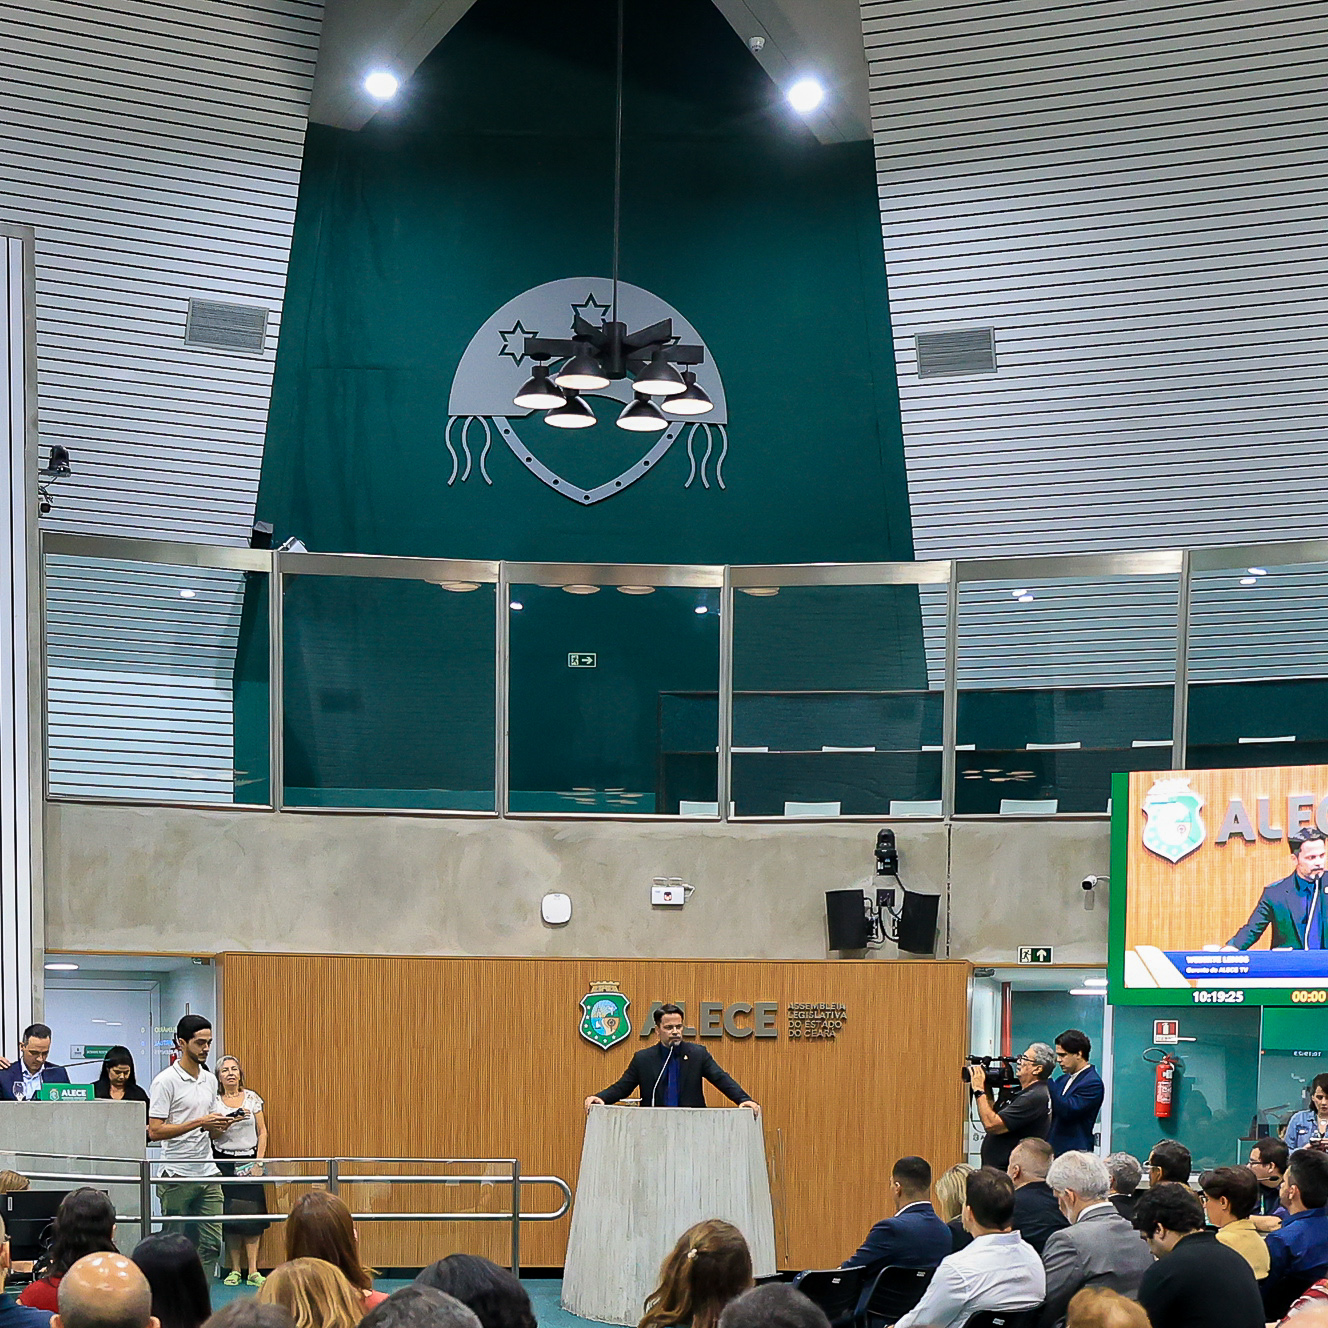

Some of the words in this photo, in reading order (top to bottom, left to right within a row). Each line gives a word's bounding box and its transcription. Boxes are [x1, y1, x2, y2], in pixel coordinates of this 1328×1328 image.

[1192, 990, 1244, 1003] 10:19:25
[1291, 990, 1327, 1003] 00:00
[787, 1002, 846, 1011] ASSEMBLEIA
[788, 1011, 847, 1020] LEGISLATIVA
[788, 1020, 801, 1028] DO
[805, 1020, 843, 1029] ESTADO
[788, 1029, 801, 1037] DO
[61, 1088, 87, 1097] ALECE
